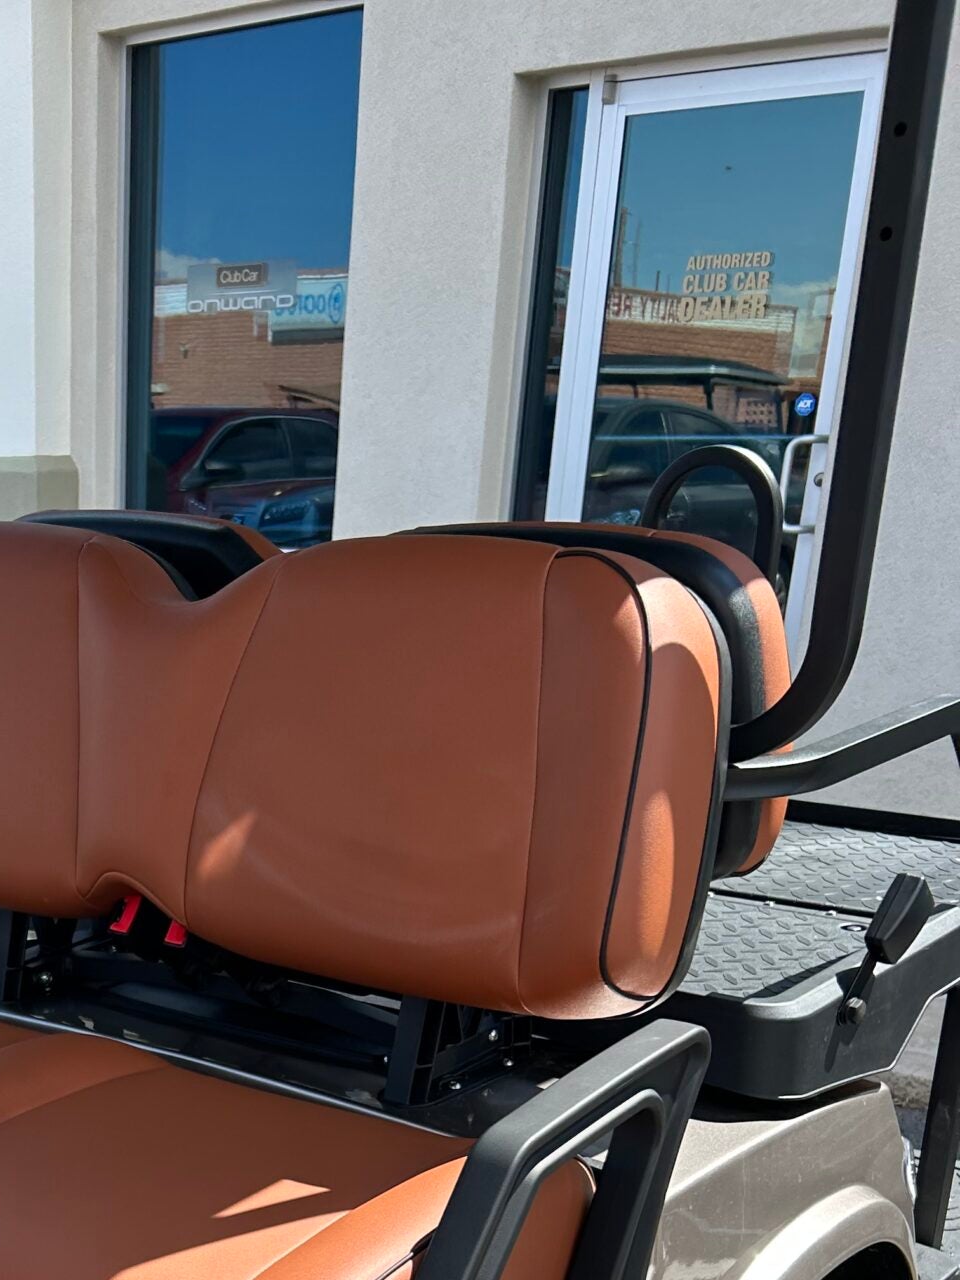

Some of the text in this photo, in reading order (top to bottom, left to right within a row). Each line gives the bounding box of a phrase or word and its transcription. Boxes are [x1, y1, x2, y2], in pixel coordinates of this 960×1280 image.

[686, 252, 772, 272] AUTHORIZED
[242, 269, 259, 282] Car
[682, 271, 771, 294] CLUB CAR
[677, 293, 768, 322] DEALER
